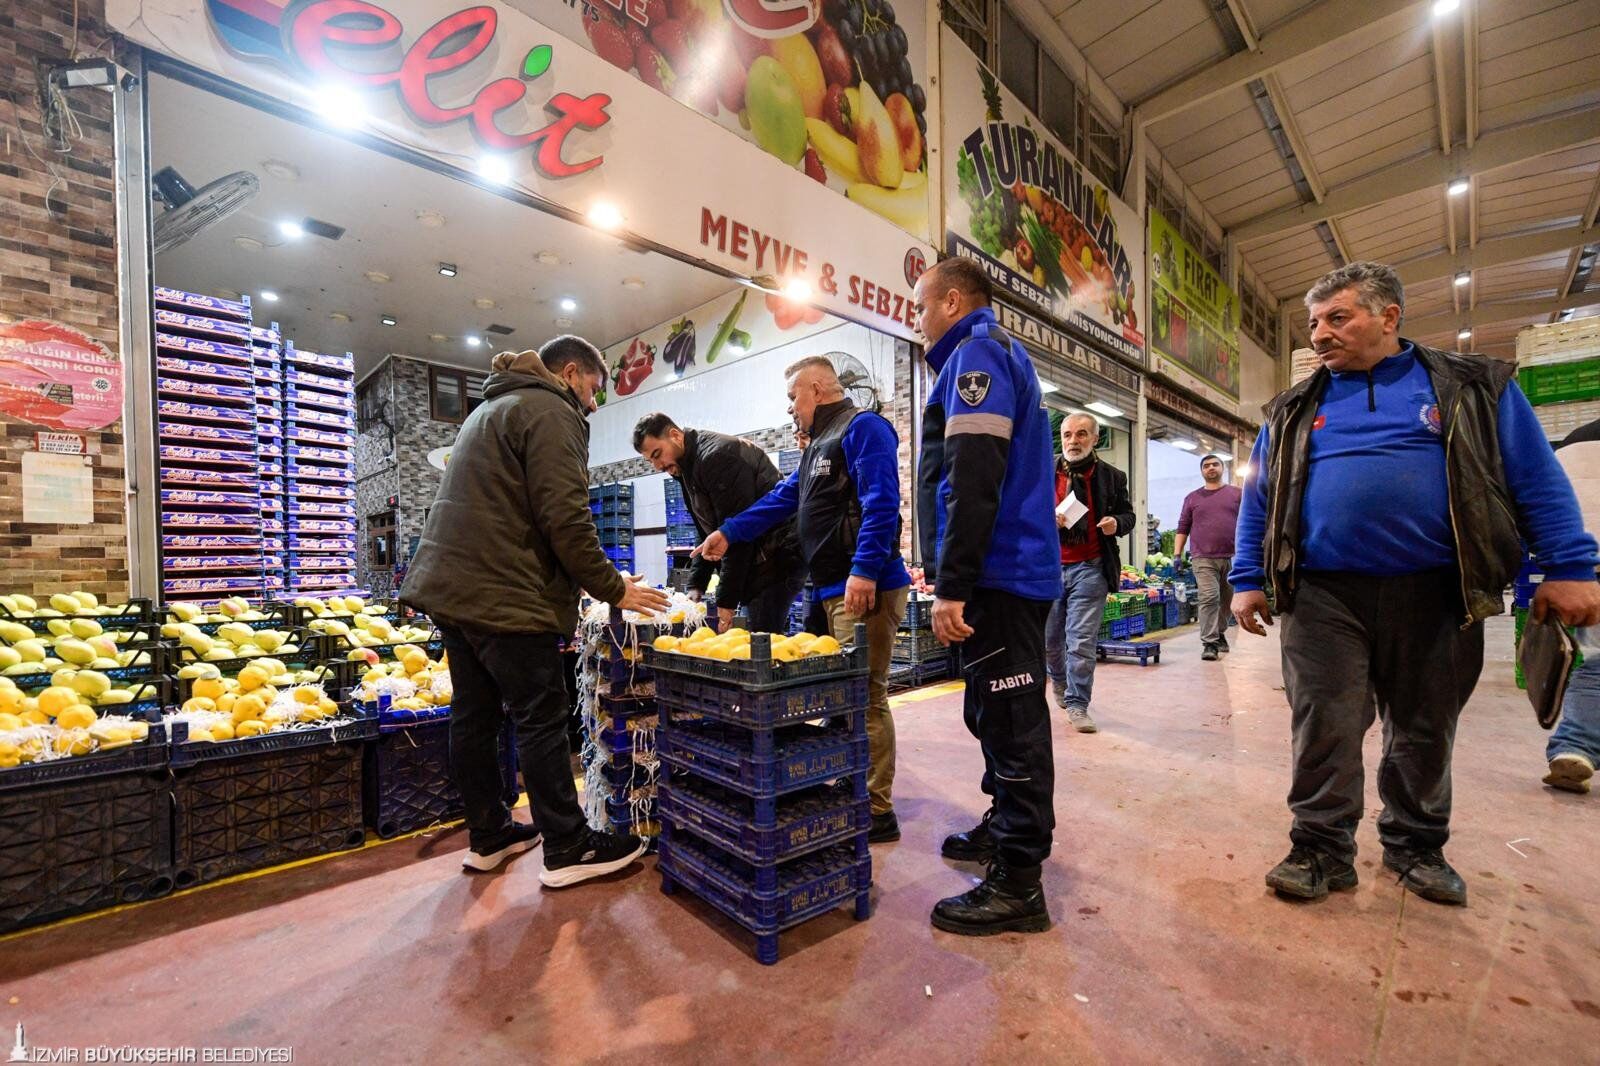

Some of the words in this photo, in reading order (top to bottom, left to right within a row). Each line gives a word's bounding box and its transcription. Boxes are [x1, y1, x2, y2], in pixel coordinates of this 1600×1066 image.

[292, 0, 612, 178] elit
[963, 121, 1132, 304] TURANLAR
[701, 206, 809, 275] MEYVE
[818, 262, 838, 296] &
[847, 274, 916, 330] SEBZE
[908, 255, 924, 280] 15
[956, 241, 1008, 285] MEYVE
[1011, 277, 1052, 310] SEBZE
[1184, 248, 1219, 306] FIRAT
[992, 300, 1101, 373] RANLAR
[73, 391, 107, 402] eterli.
[990, 673, 1034, 692] ZABITA
